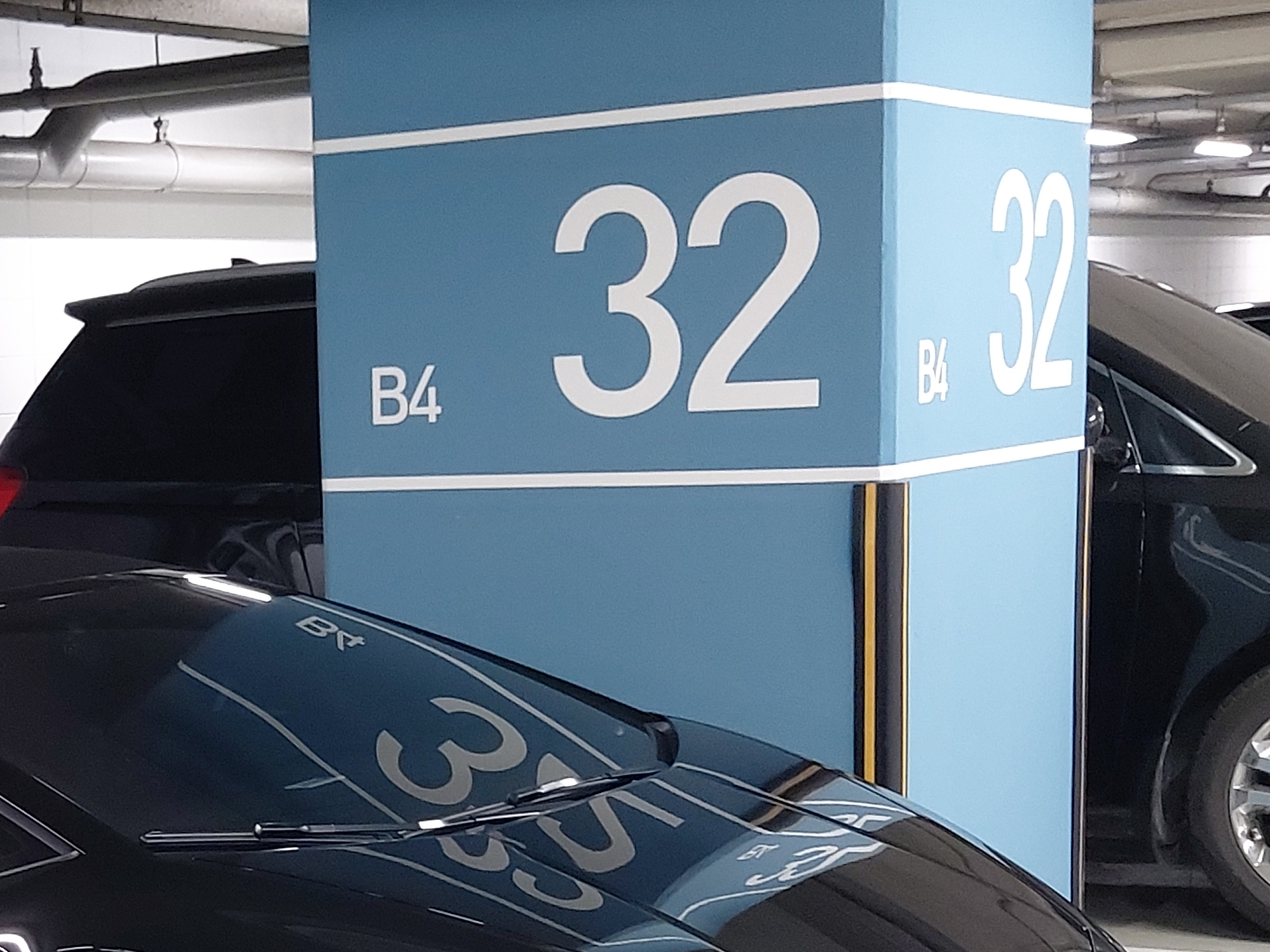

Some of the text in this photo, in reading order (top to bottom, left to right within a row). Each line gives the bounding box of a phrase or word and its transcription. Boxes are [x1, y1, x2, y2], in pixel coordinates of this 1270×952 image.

[553, 171, 820, 419] 32
[987, 167, 1075, 396] 32
[370, 364, 442, 426] B4
[918, 338, 949, 404] B4
